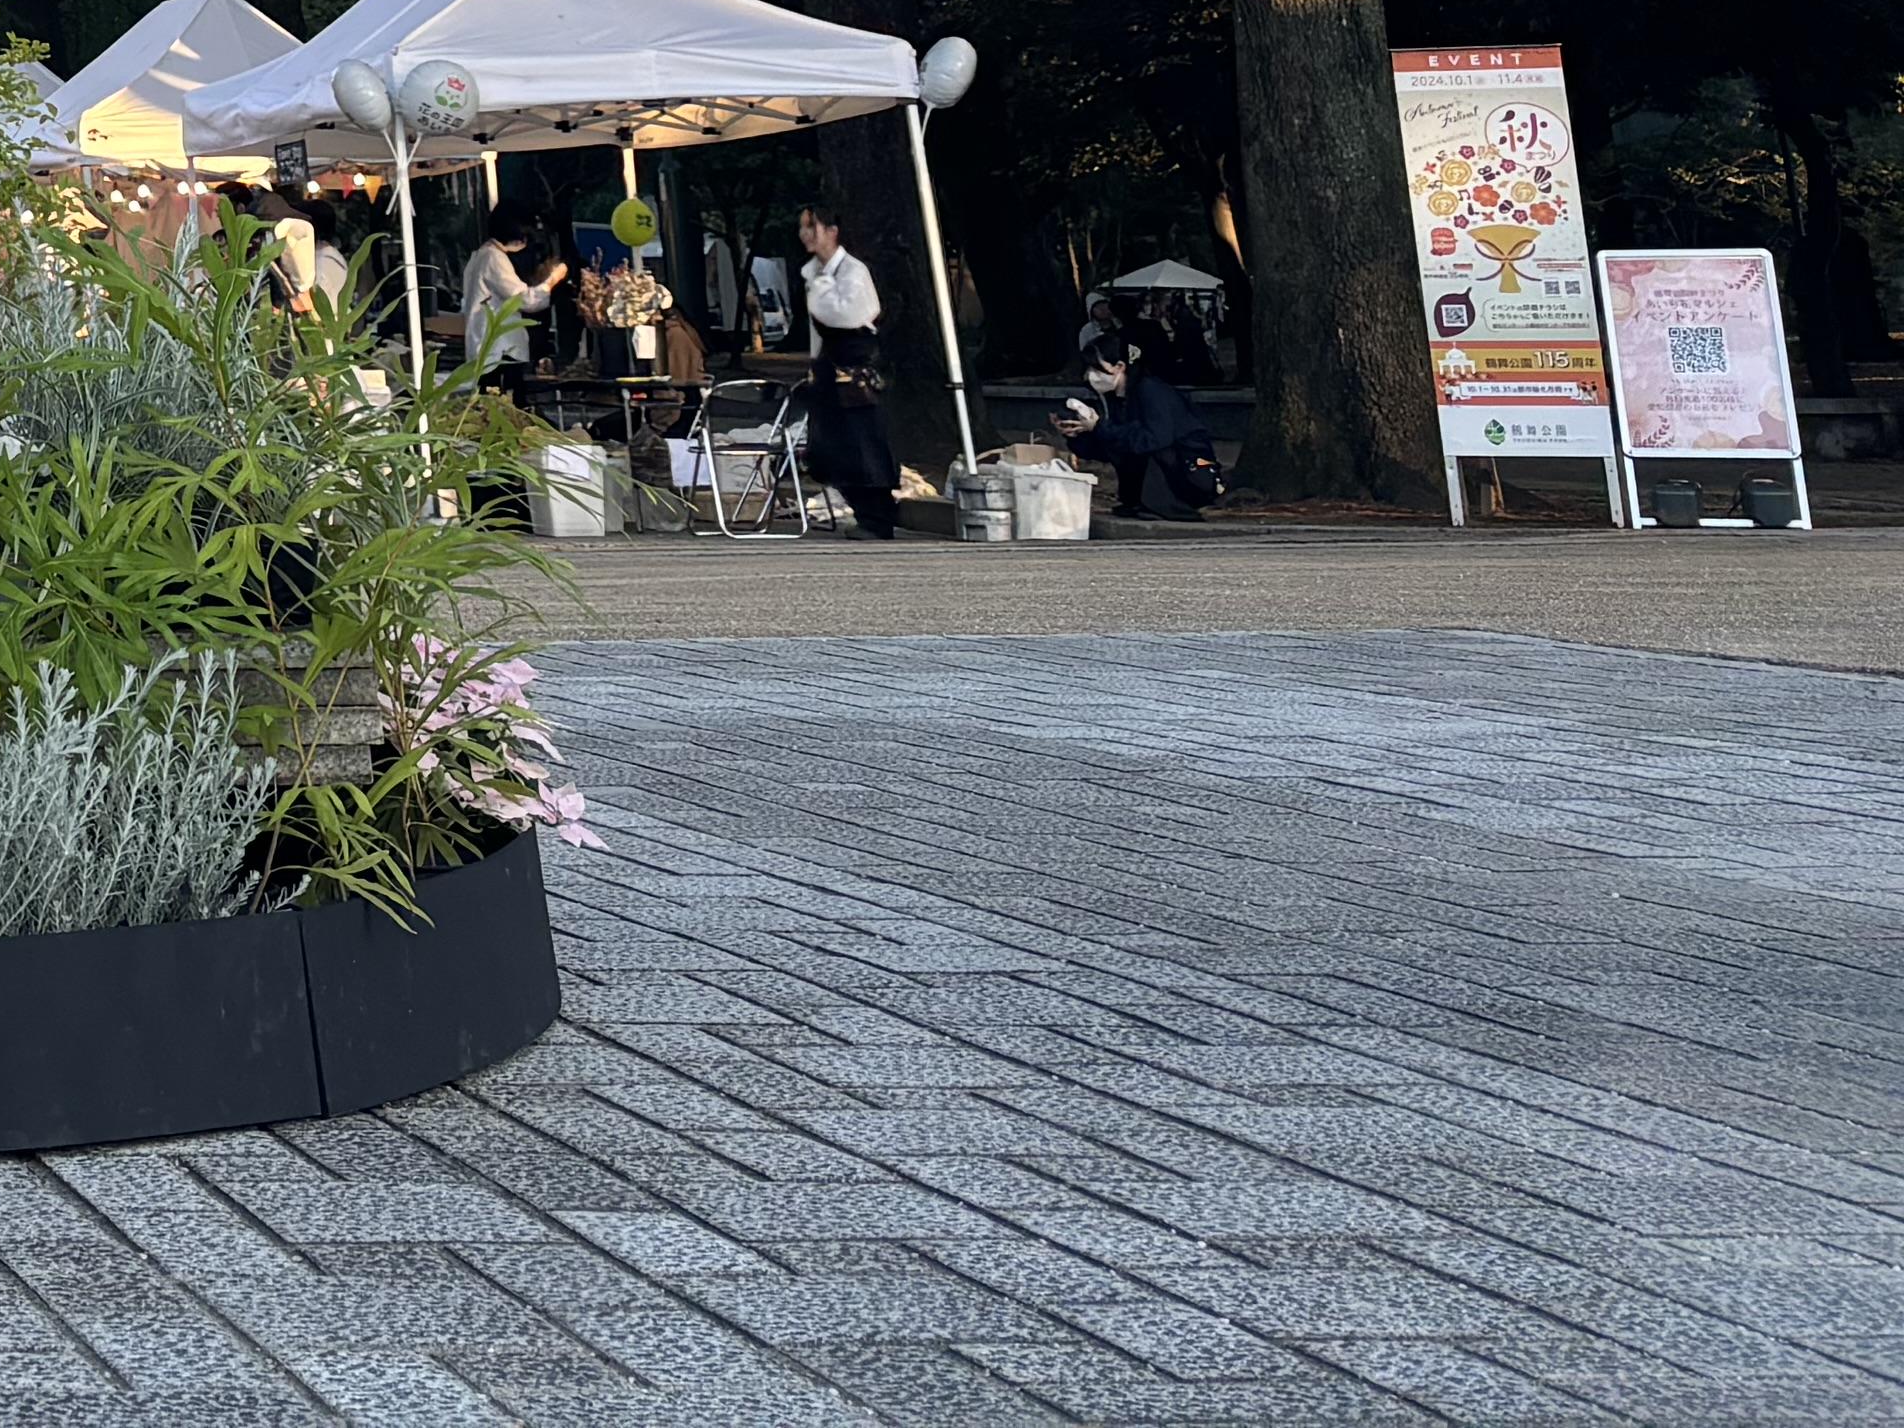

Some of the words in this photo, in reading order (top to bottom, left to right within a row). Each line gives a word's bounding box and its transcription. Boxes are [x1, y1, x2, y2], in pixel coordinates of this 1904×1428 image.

[1428, 53, 1523, 67] EVENT
[1499, 110, 1553, 153] 秋
[1633, 311, 1759, 322] イベントアンケート
